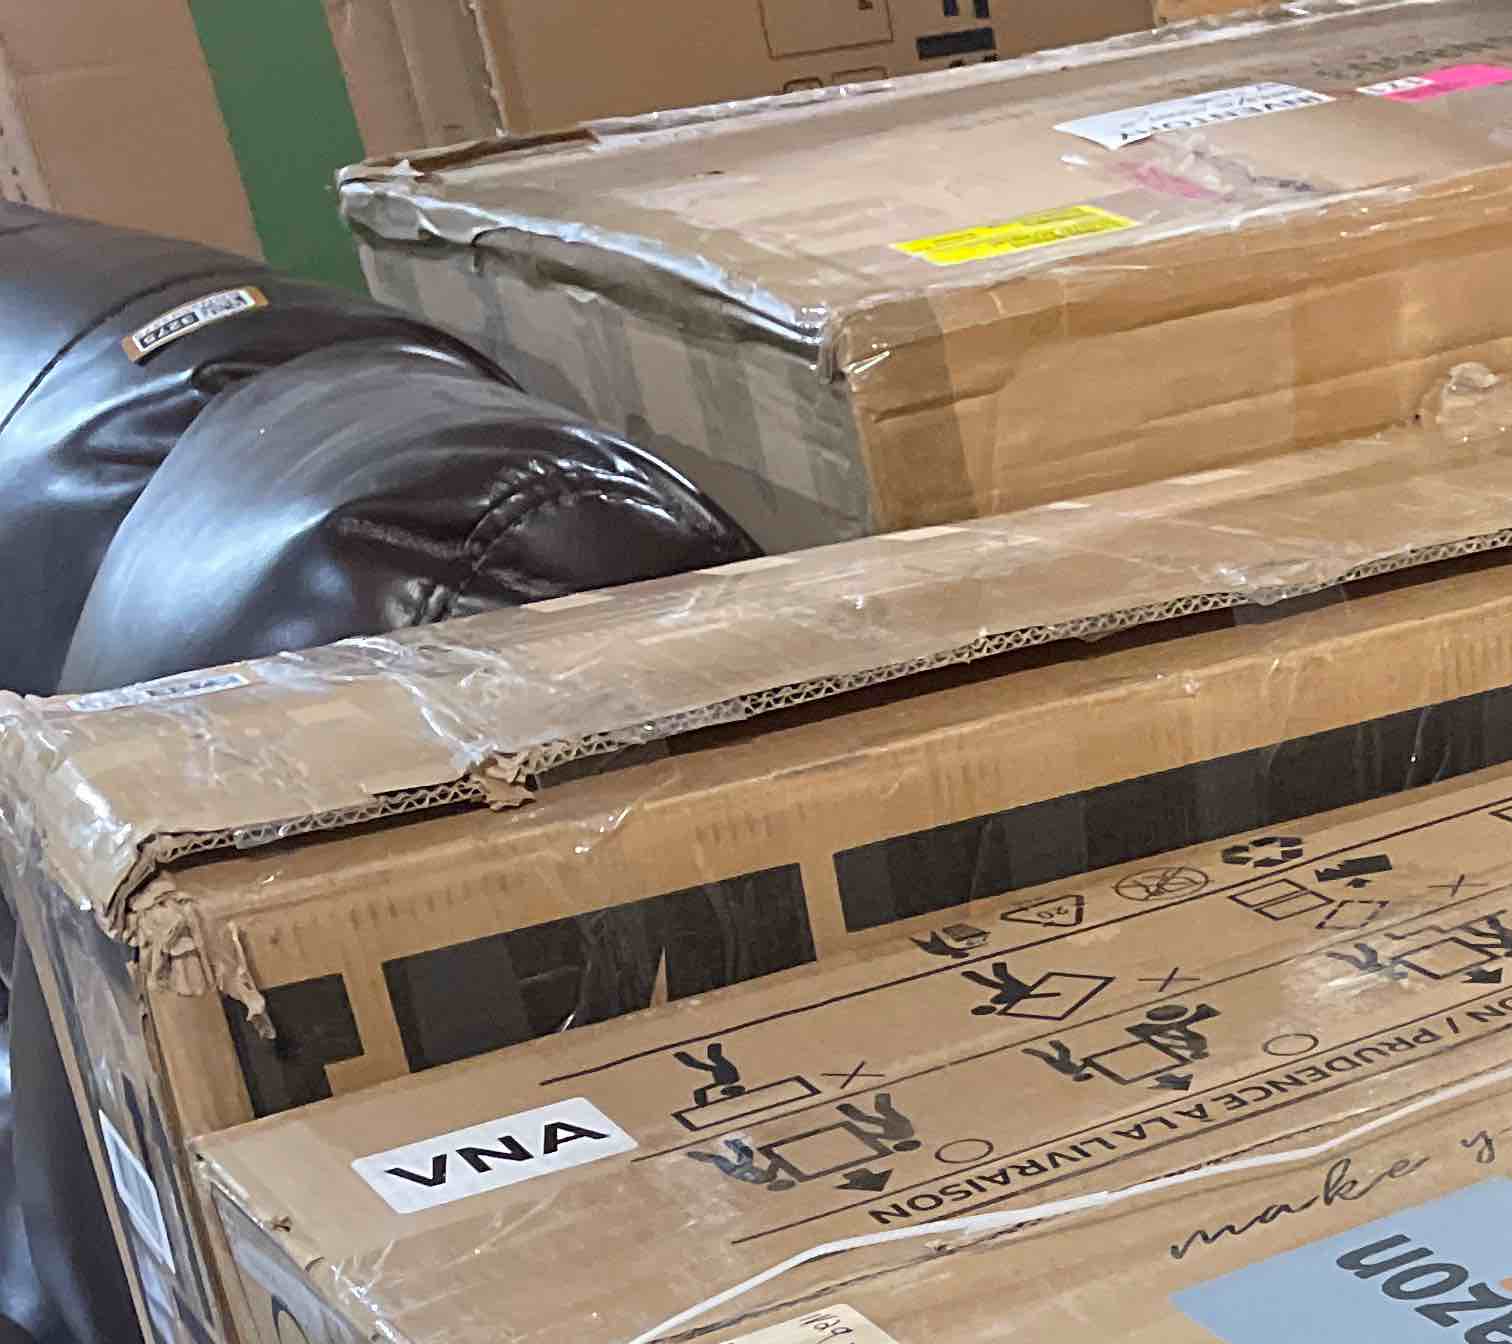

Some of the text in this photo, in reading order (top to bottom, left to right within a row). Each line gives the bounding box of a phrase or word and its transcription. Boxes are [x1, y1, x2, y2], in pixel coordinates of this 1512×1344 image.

[1210, 1026, 1443, 1112] PRUDENCE
[385, 1119, 611, 1188] VNA
[1112, 1115, 1179, 1142] LA
[868, 1137, 1118, 1225] LIVRAISON
[1170, 1157, 1432, 1260] make
